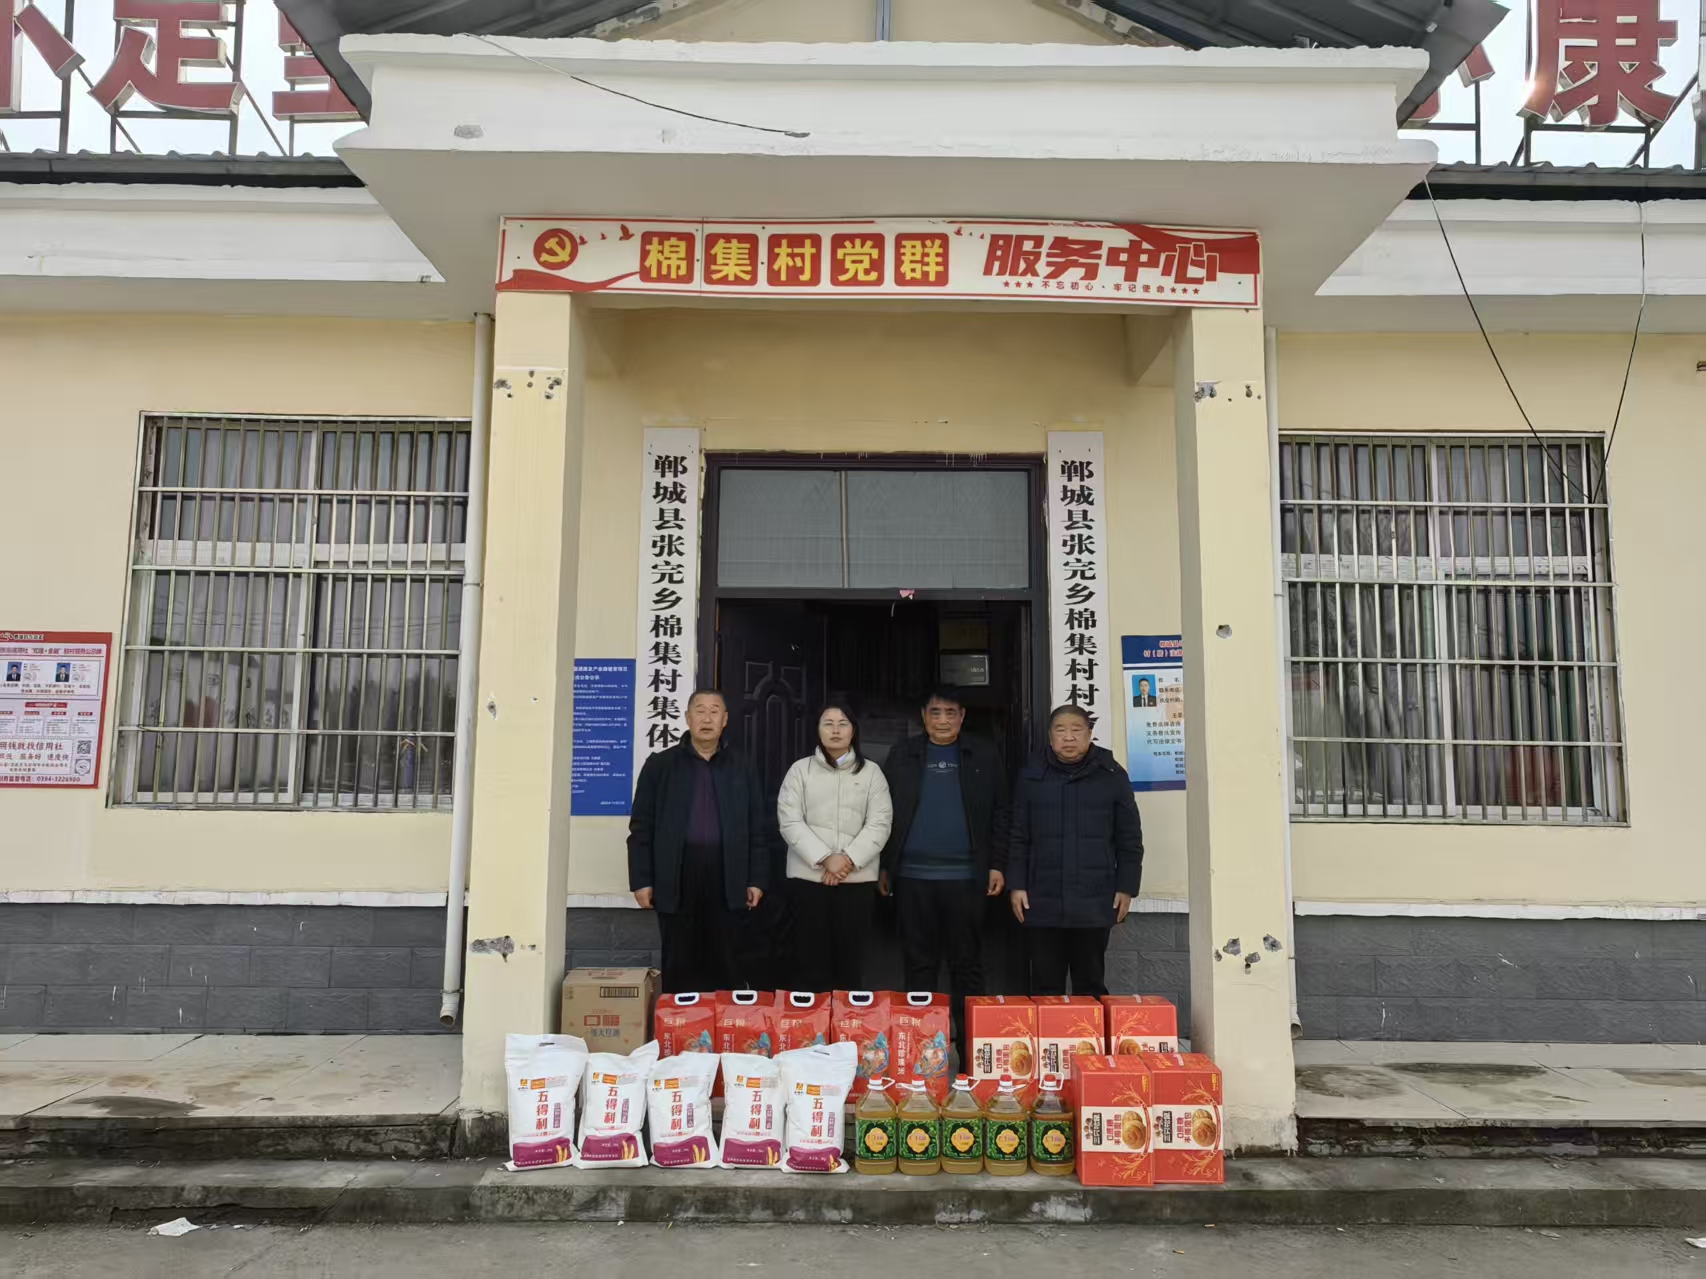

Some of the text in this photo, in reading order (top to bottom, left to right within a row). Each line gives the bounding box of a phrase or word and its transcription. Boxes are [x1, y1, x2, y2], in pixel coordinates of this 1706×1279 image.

[644, 233, 1220, 285] 棉集村党群 服务中心
[645, 454, 688, 748] 郸城县张完乡棉集村集体
[1060, 460, 1100, 742] 郸城县张完乡棉集村村
[536, 1091, 549, 1130] 五得利
[604, 1087, 619, 1124] 五得利
[671, 1091, 682, 1130] 五得利
[749, 1091, 762, 1129] 五得利
[811, 1098, 824, 1137] 五得利
